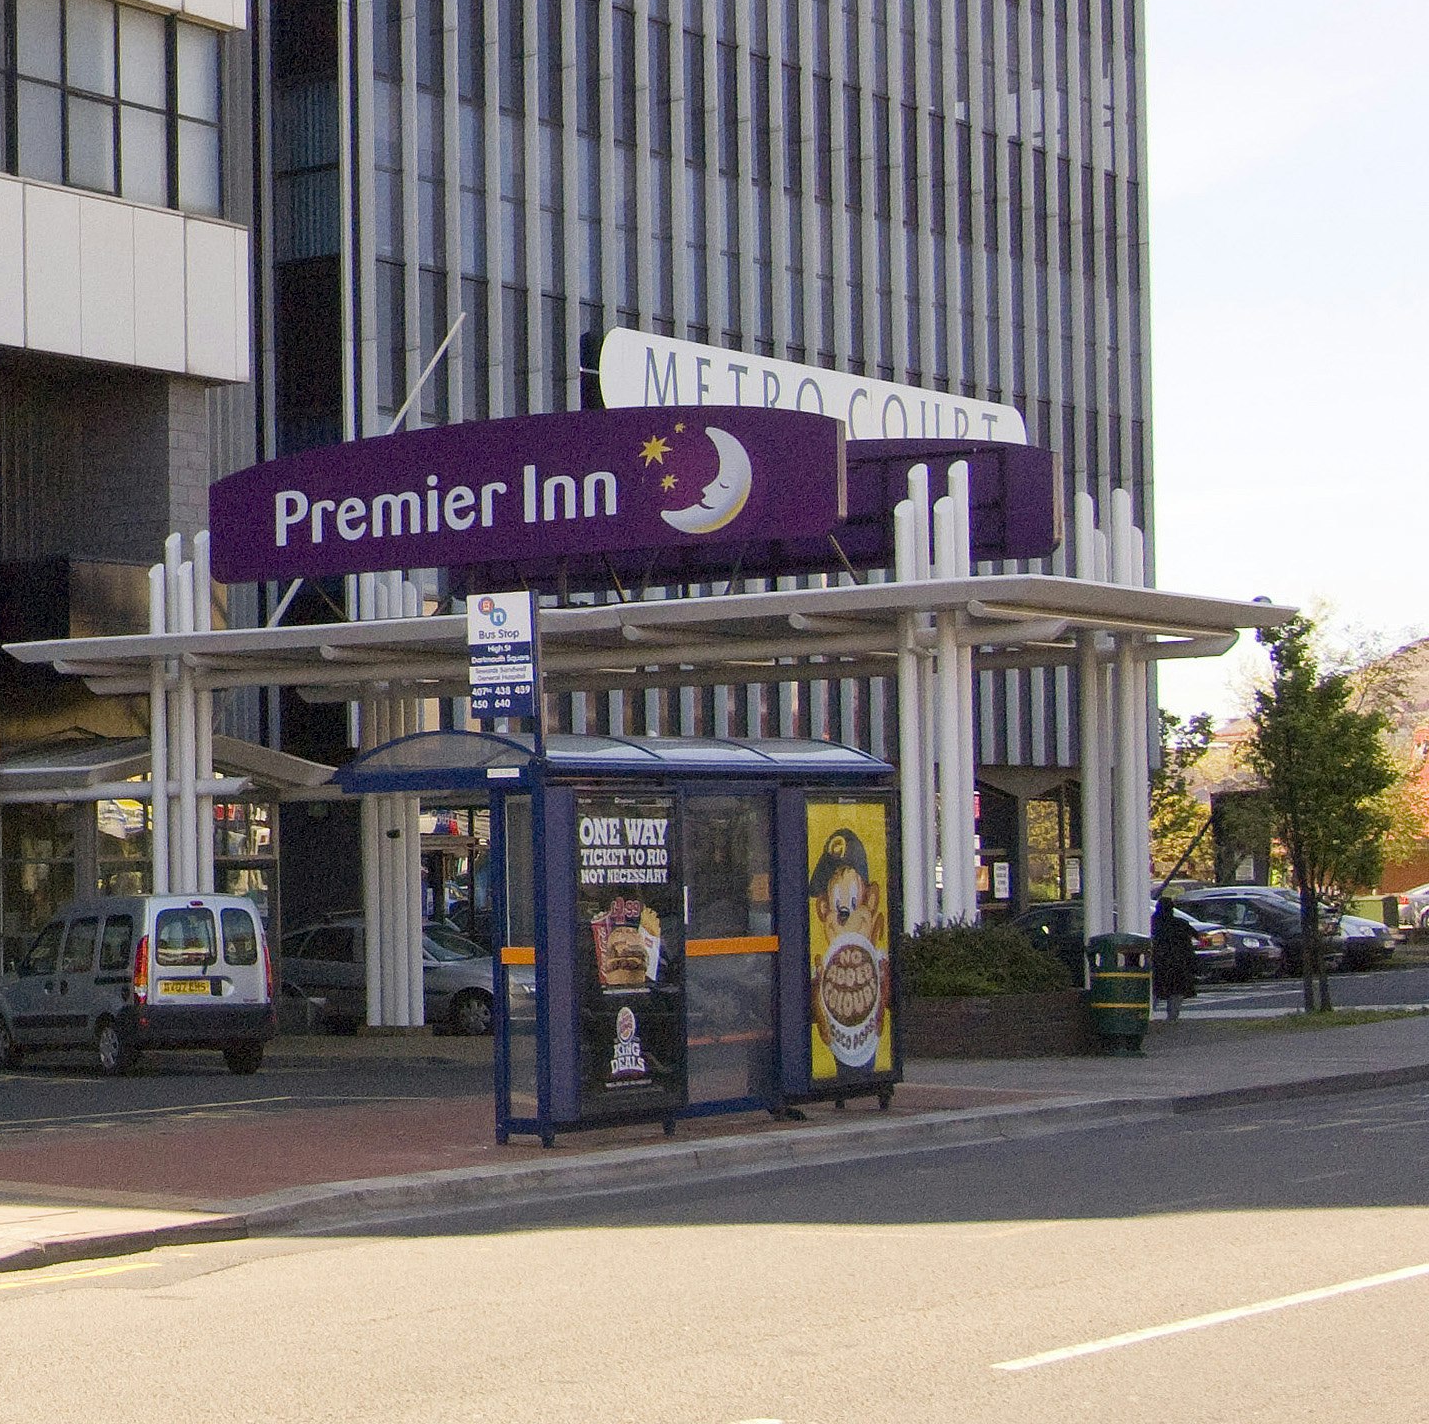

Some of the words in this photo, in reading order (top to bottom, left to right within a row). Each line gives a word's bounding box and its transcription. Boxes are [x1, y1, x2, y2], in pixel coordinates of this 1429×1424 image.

[644, 346, 824, 413] METRO
[275, 476, 507, 547] Premier
[523, 465, 618, 523] Inn
[478, 630, 496, 640] Bus
[498, 629, 520, 639] Stop
[487, 645, 503, 654] High
[494, 686, 511, 695] 438
[472, 699, 489, 709] 450
[494, 698, 511, 708] 640
[579, 817, 621, 845] ONE
[624, 818, 668, 845] WAY
[581, 849, 626, 865] TICKET
[627, 849, 644, 865] TO
[646, 848, 668, 865] RIO
[581, 868, 605, 884] NOT
[607, 868, 668, 883] NECESSARY
[613, 1042, 641, 1059] KING
[610, 1056, 646, 1074] DEALS
